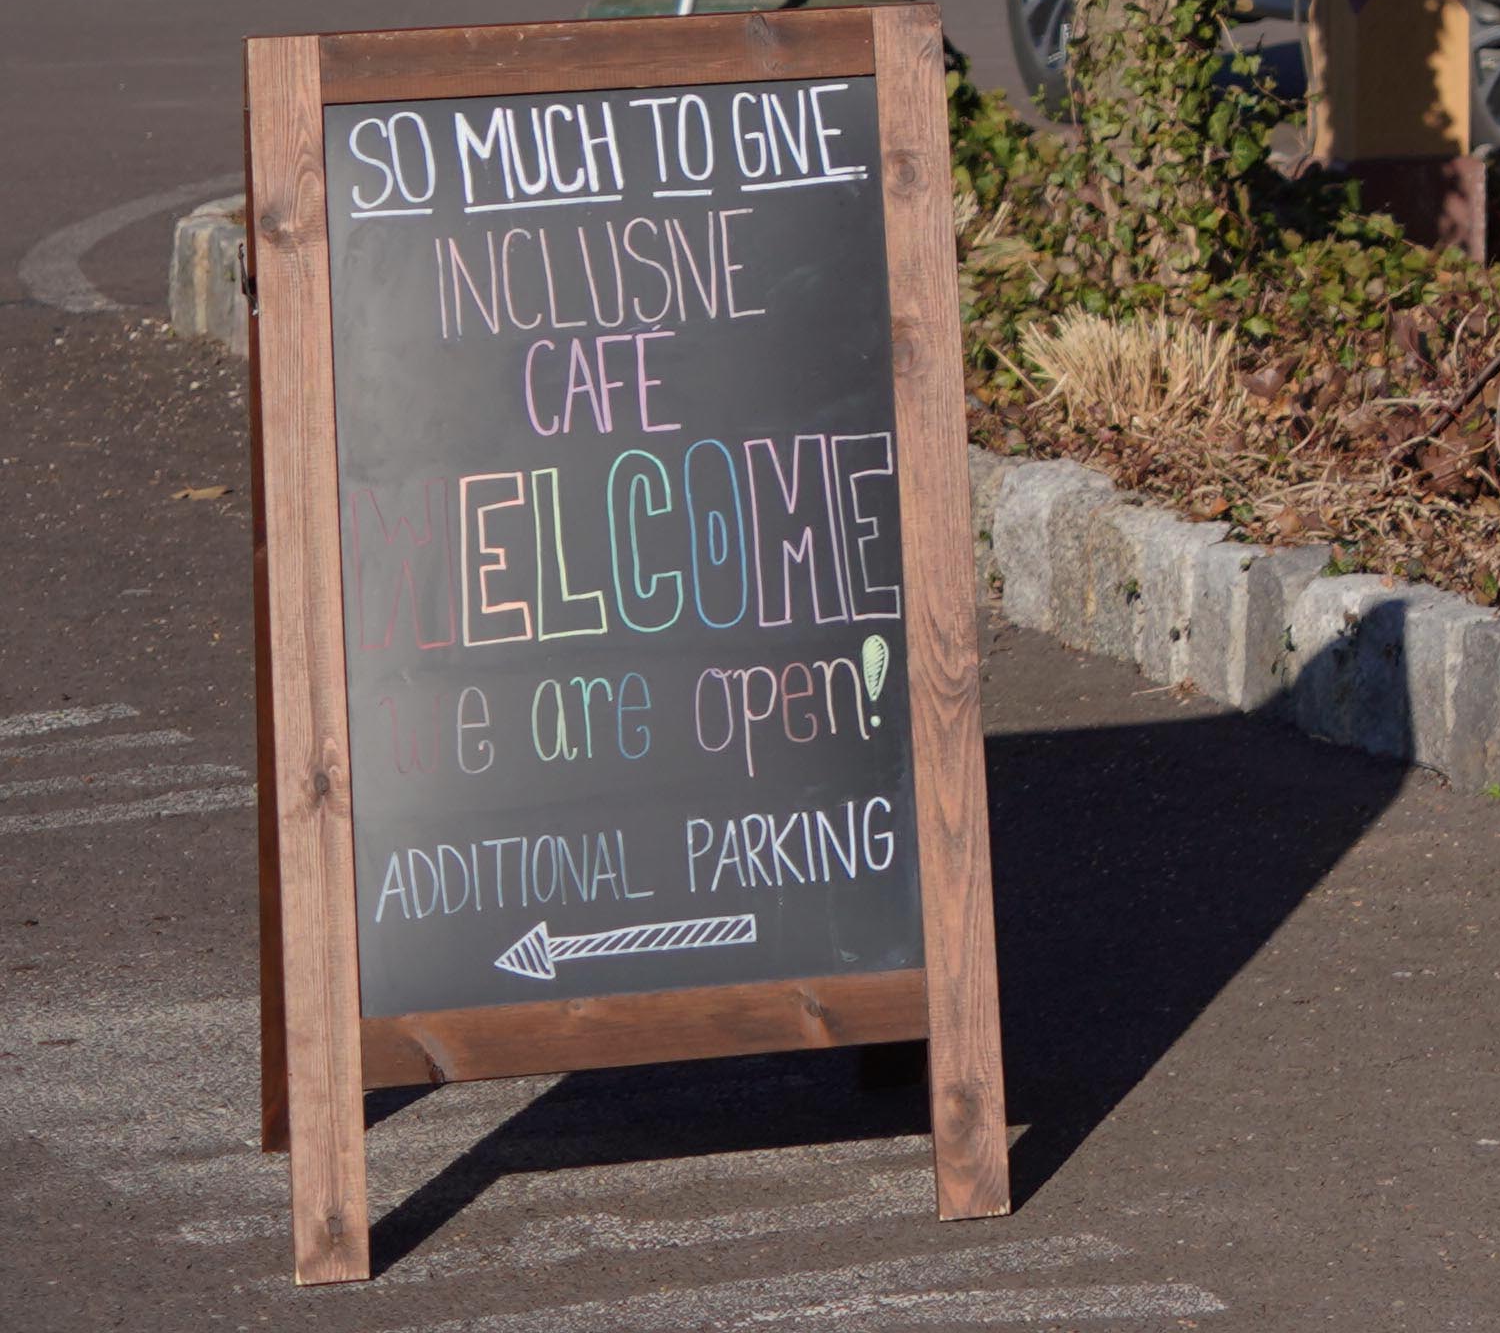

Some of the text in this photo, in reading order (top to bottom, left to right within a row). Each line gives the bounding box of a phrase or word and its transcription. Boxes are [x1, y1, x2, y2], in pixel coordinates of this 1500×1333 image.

[349, 84, 867, 209] SO MUCH TO GIVE
[435, 208, 766, 338] INCLUSIVE
[352, 432, 900, 650] WELCOME
[379, 634, 890, 778] we are open!
[376, 796, 894, 923] ADDITIONAL PARKING
